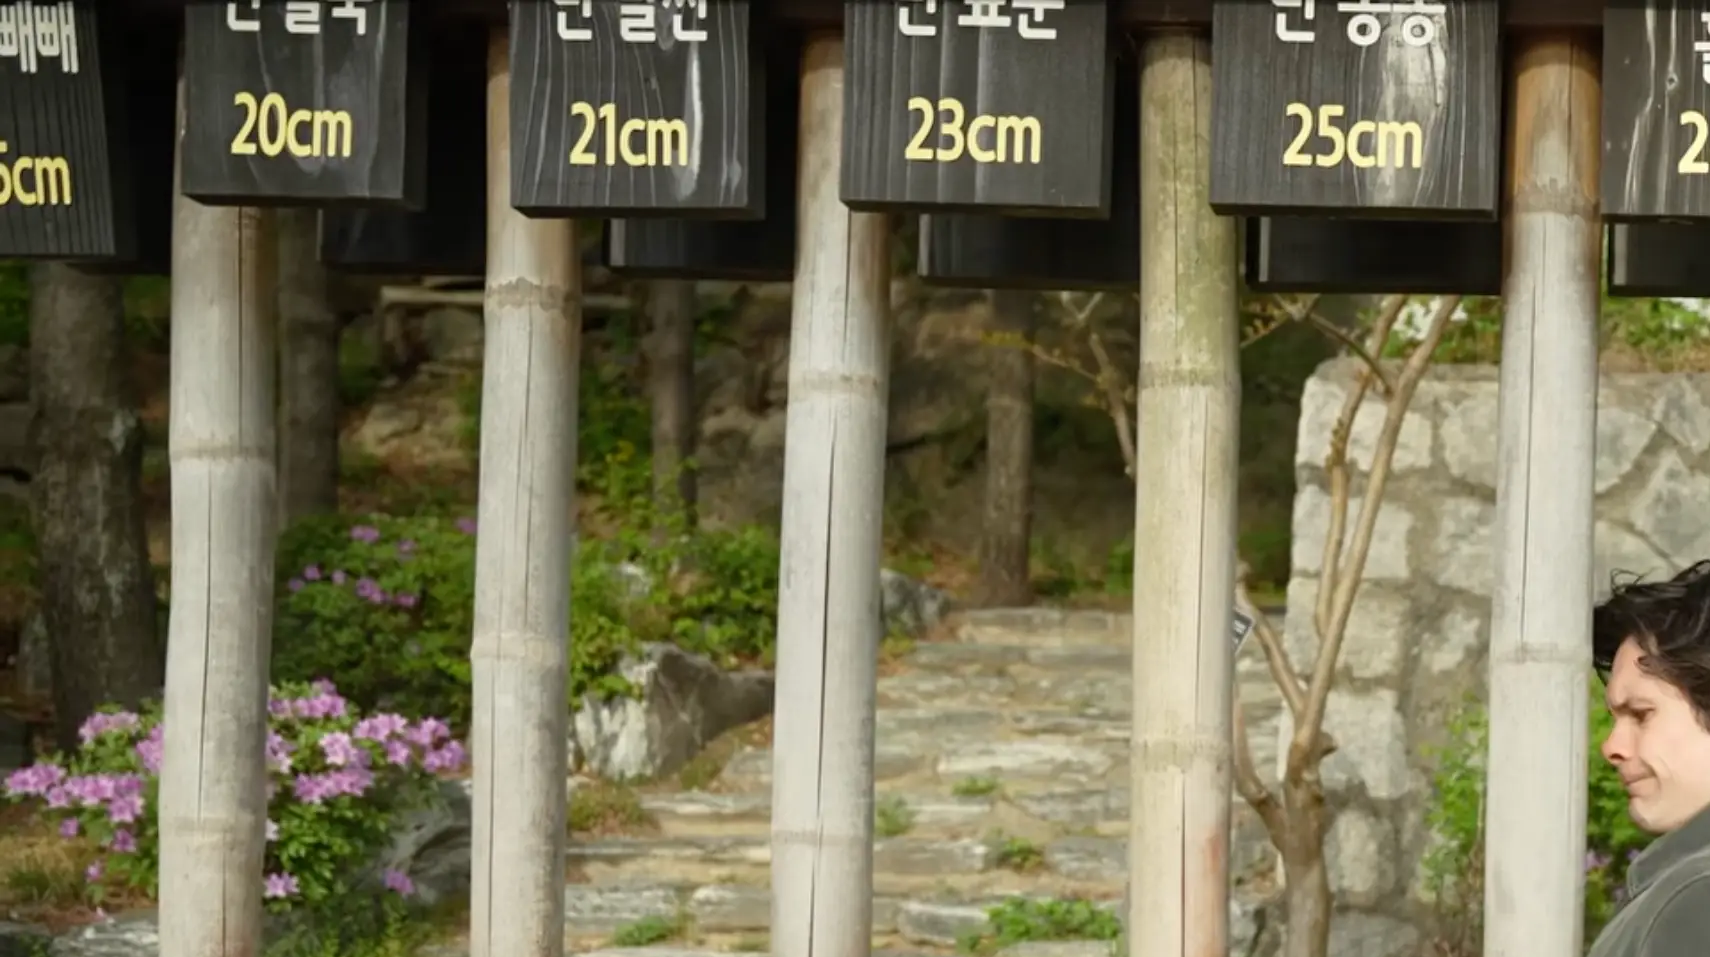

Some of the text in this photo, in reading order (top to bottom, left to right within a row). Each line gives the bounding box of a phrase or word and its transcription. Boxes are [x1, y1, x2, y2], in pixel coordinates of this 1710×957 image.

[230, 92, 353, 158] 20cm
[569, 102, 688, 166] 21cm
[904, 96, 1041, 164] 23cm
[1282, 103, 1423, 169] 25cm
